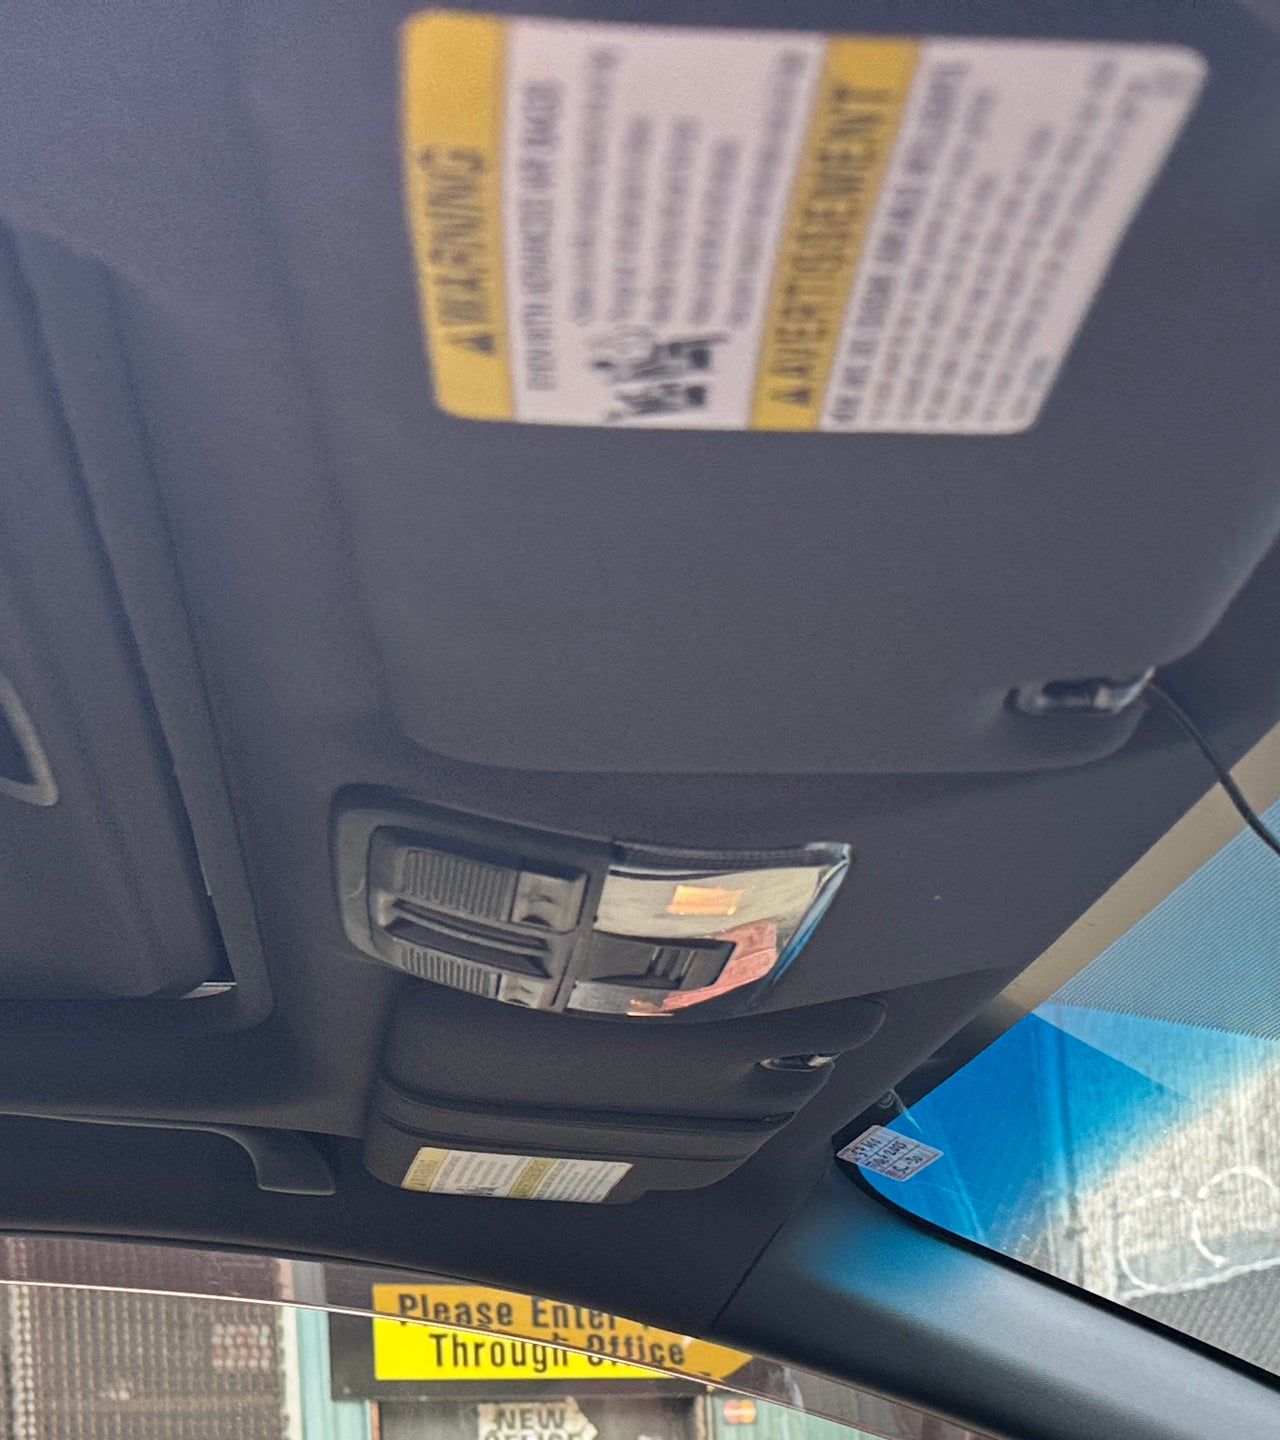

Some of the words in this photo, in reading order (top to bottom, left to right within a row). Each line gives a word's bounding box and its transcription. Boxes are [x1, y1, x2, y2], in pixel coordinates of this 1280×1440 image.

[417, 147, 490, 327] WARNING
[397, 1293, 513, 1327] Please
[429, 1332, 568, 1373] Through
[587, 1333, 685, 1367] Office
[495, 1408, 565, 1430] NEW
